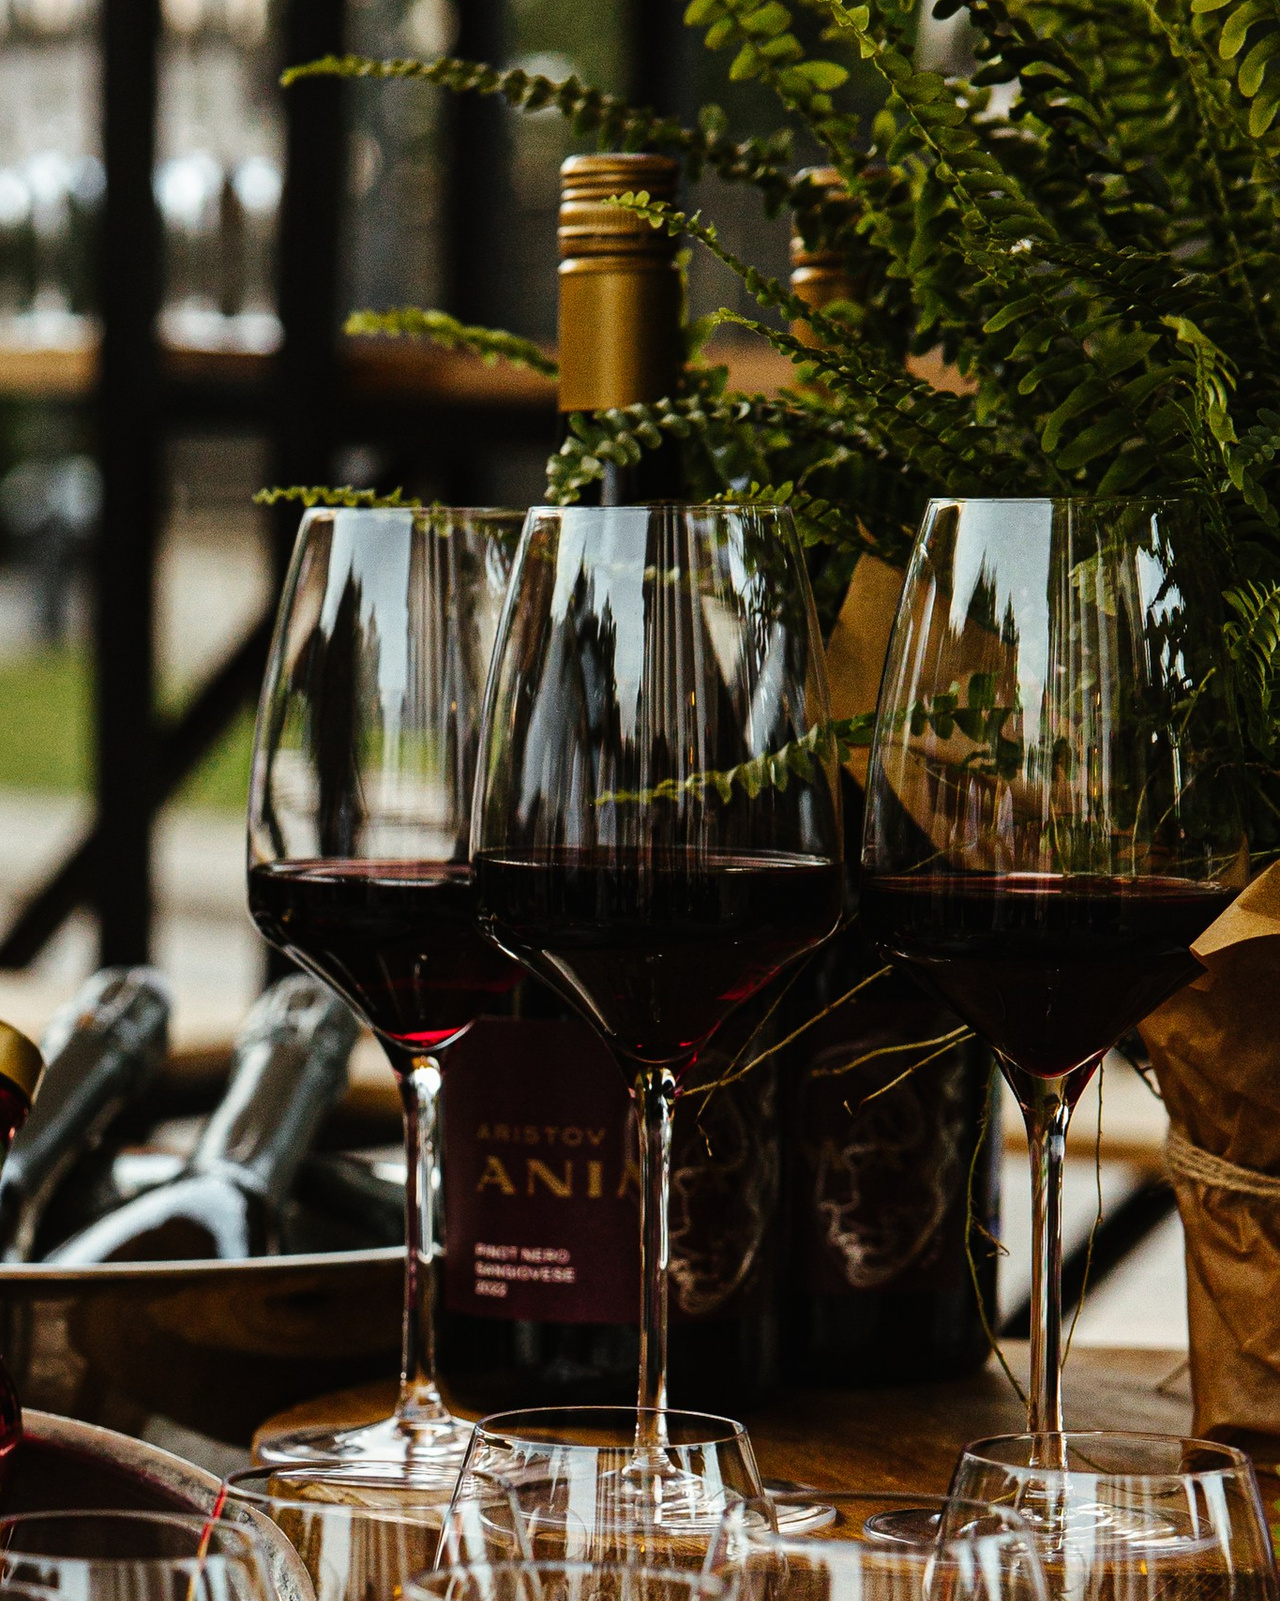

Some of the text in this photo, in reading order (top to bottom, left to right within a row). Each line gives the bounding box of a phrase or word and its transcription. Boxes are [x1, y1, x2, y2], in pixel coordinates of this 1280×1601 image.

[476, 1122, 606, 1146] ARISTOV
[475, 1242, 570, 1265] PINOT NERO
[475, 1261, 576, 1284] SANGIOVESE
